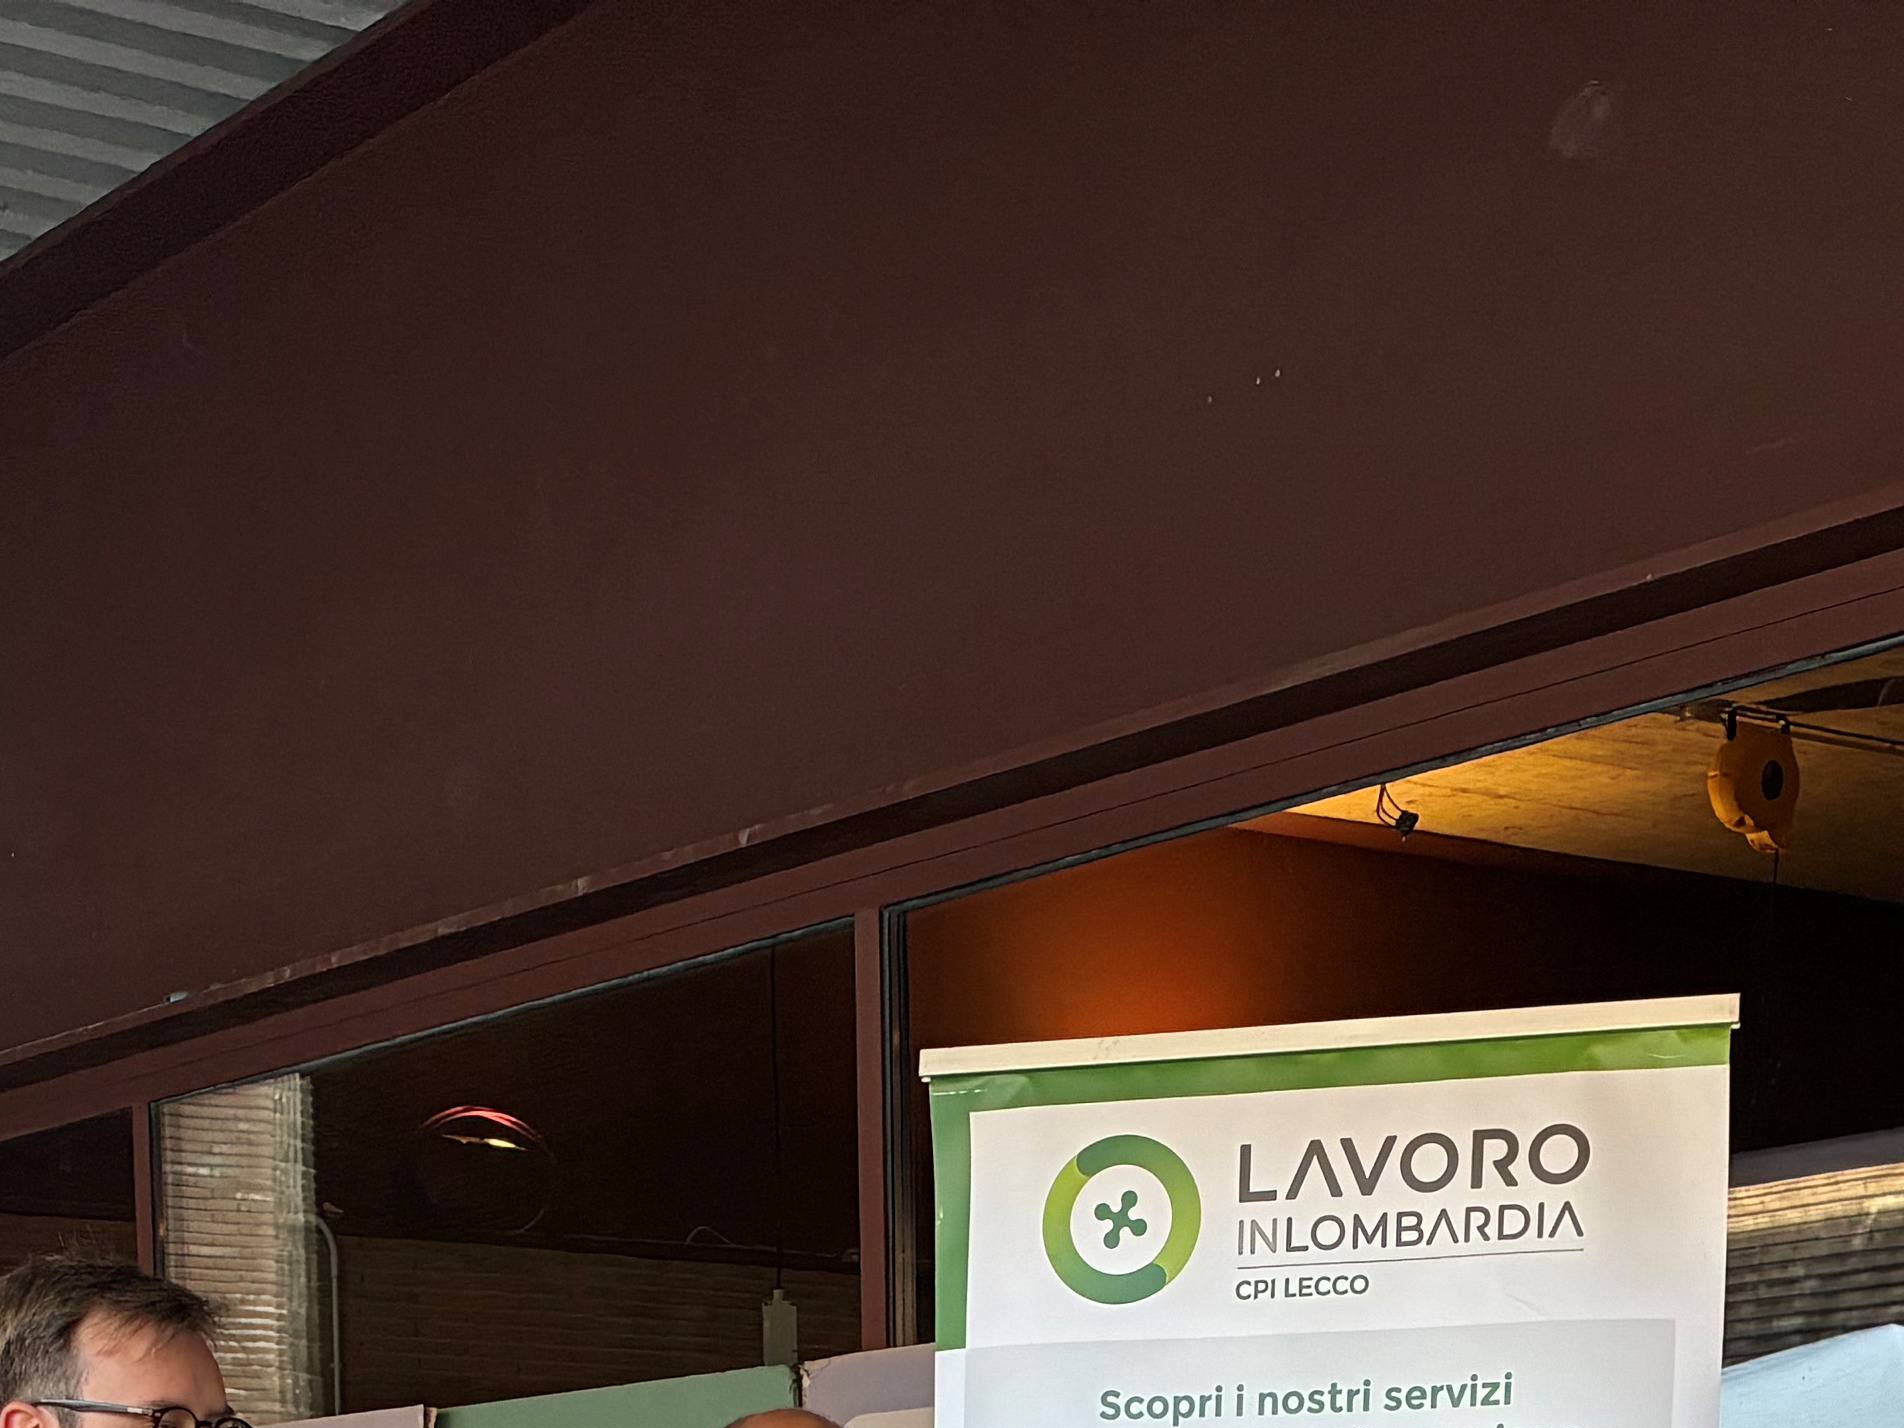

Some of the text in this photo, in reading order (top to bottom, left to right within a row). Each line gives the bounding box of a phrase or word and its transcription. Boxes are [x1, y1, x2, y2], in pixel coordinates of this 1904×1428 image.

[1239, 1123, 1590, 1203] LAVORO
[1238, 1200, 1584, 1255] INLOMBARDIA
[1235, 1274, 1369, 1300] CPI LECCO
[1100, 1371, 1512, 1427] Scopri i nostri servizi
